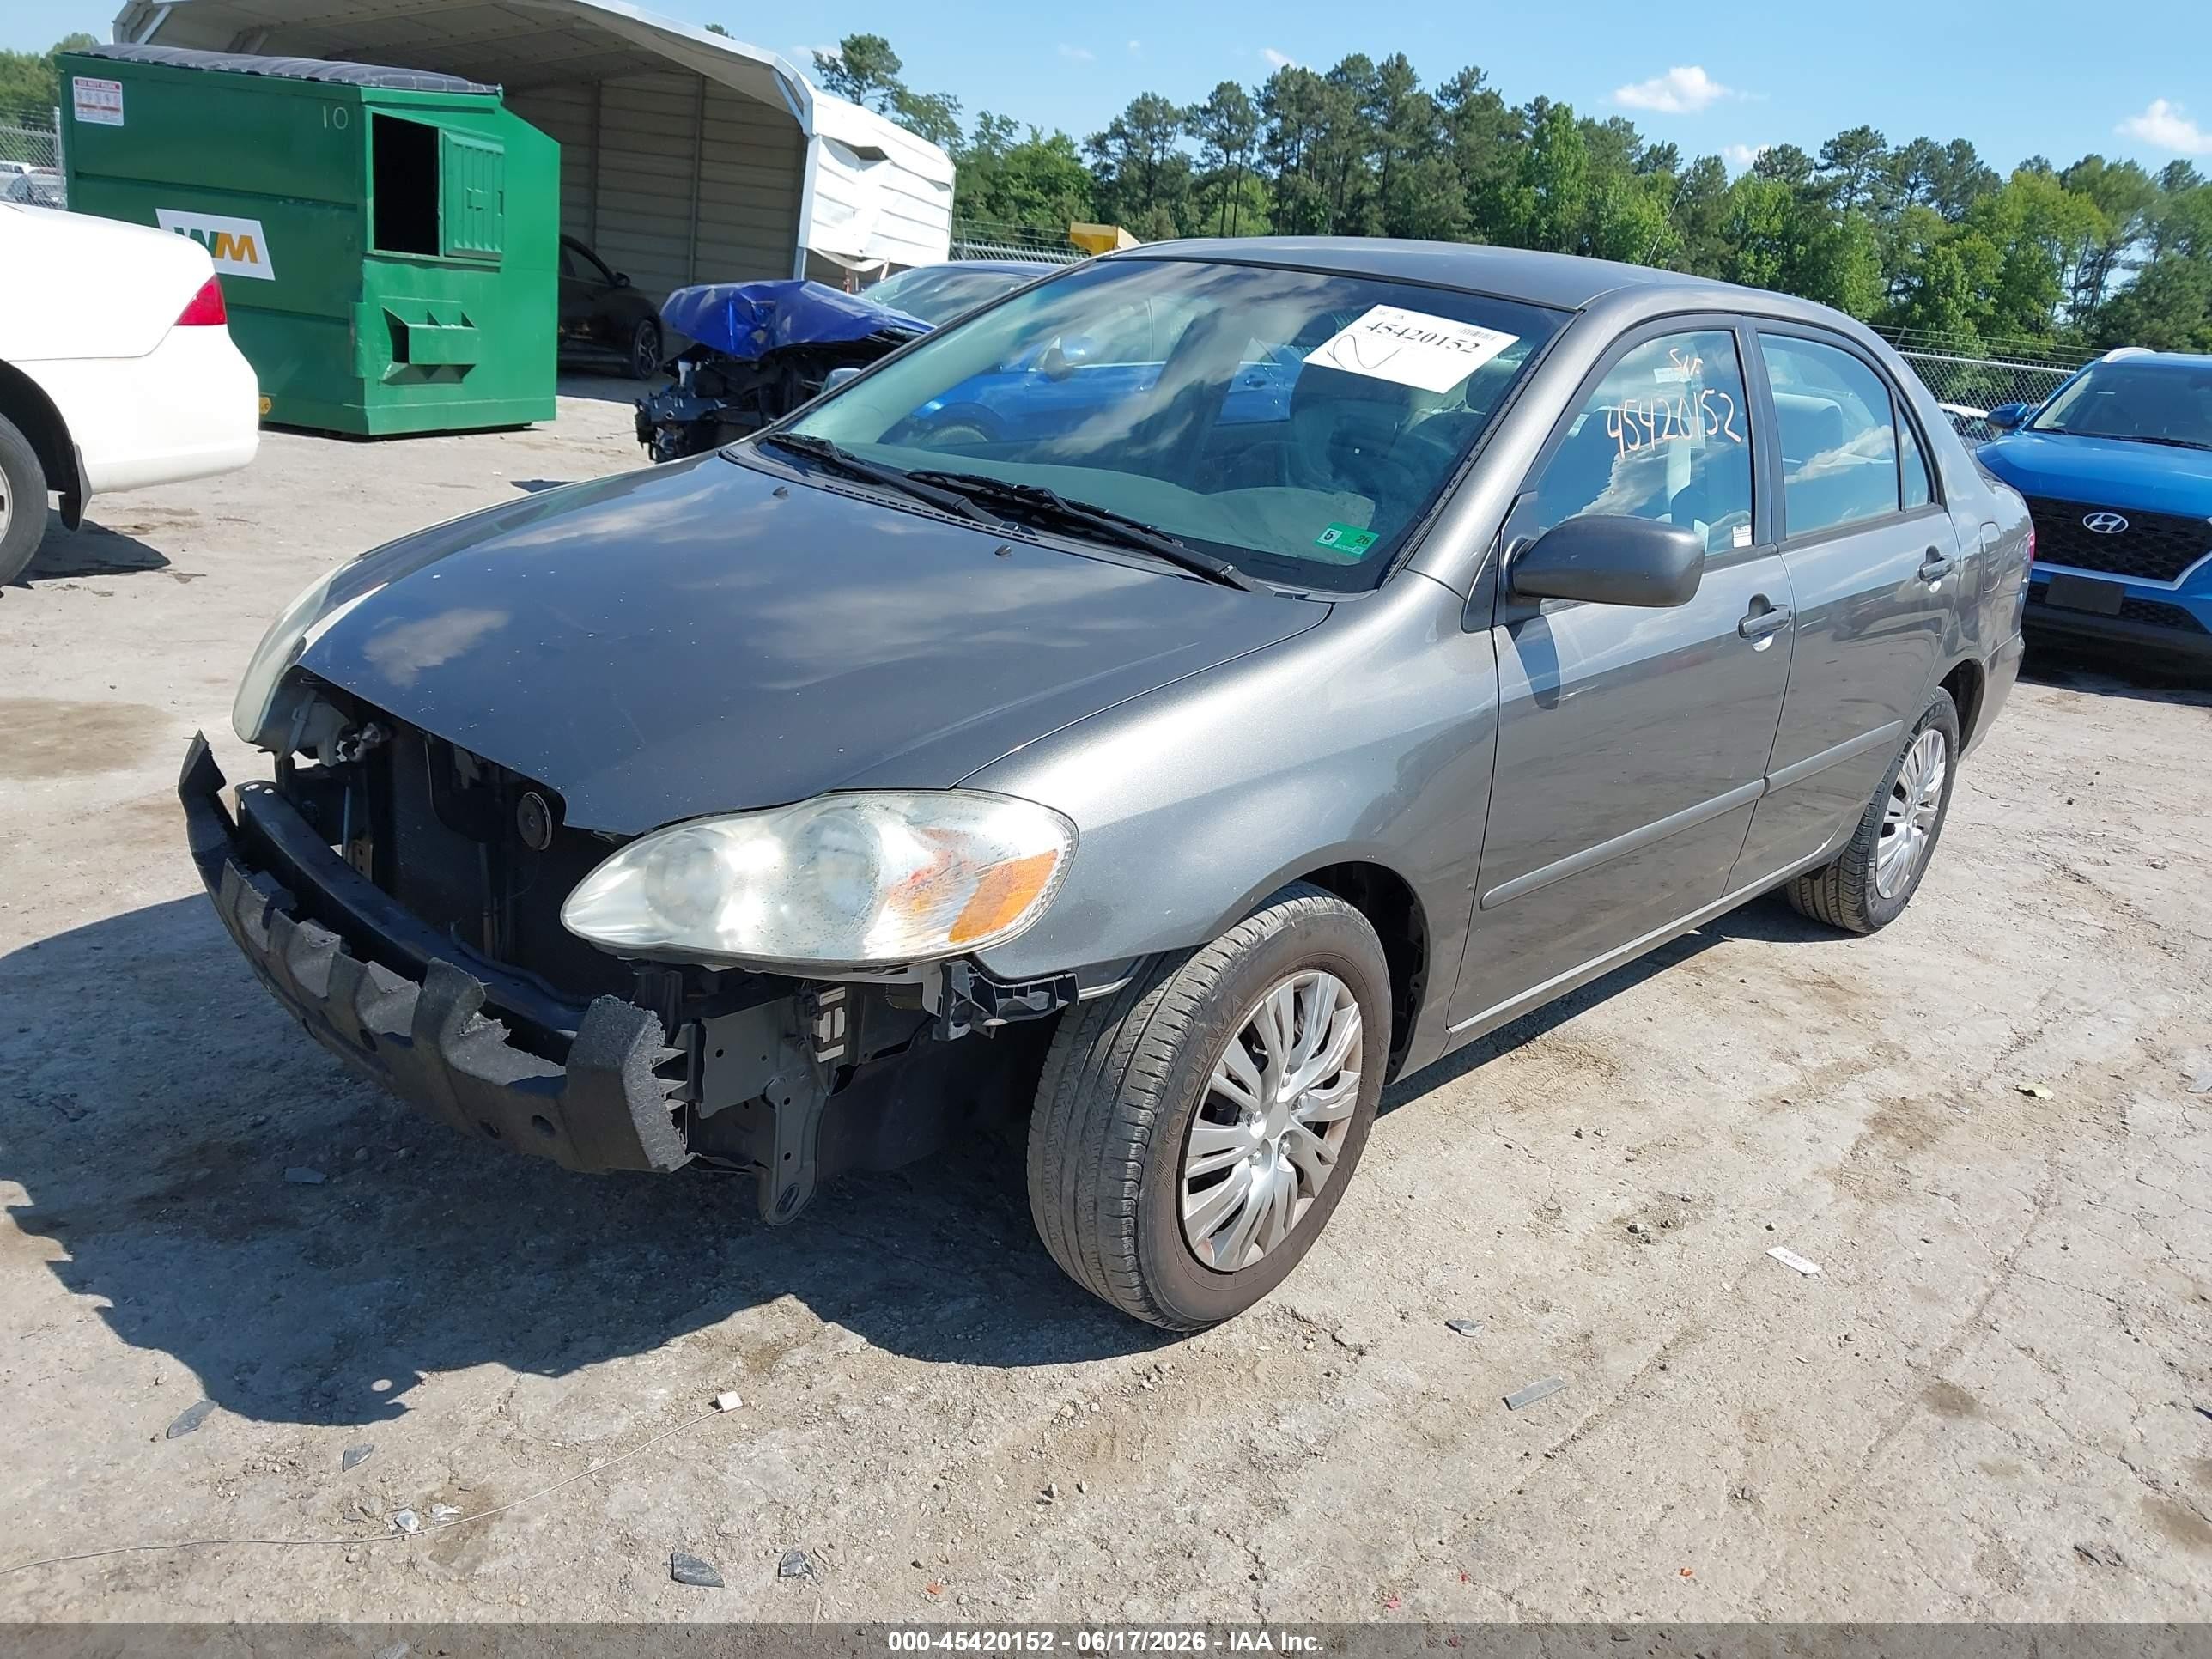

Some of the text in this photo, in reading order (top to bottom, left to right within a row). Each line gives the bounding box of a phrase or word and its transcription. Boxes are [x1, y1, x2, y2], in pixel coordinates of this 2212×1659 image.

[1366, 321, 1481, 354] 45420152
[1607, 389, 1742, 459] 45420152
[1356, 535, 1372, 545] 26
